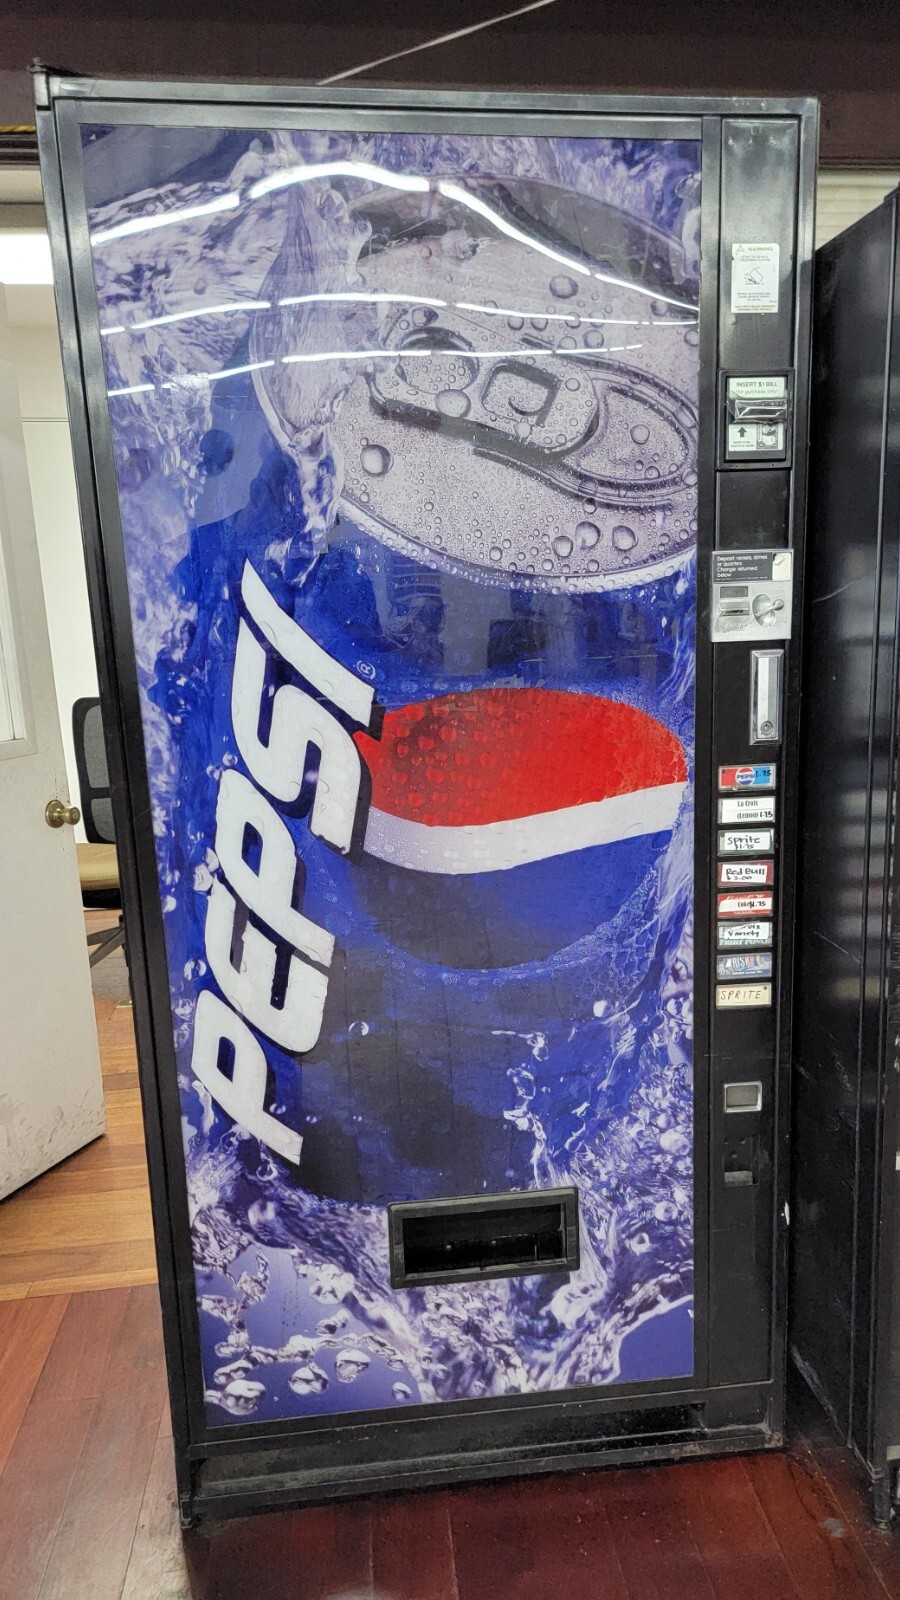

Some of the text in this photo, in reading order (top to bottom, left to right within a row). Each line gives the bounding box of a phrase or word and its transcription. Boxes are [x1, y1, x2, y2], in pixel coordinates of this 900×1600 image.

[191, 557, 377, 1166] PEPSI
[726, 868, 743, 876] Red
[728, 930, 760, 938] Variety
[720, 990, 761, 1001] SPRITE
